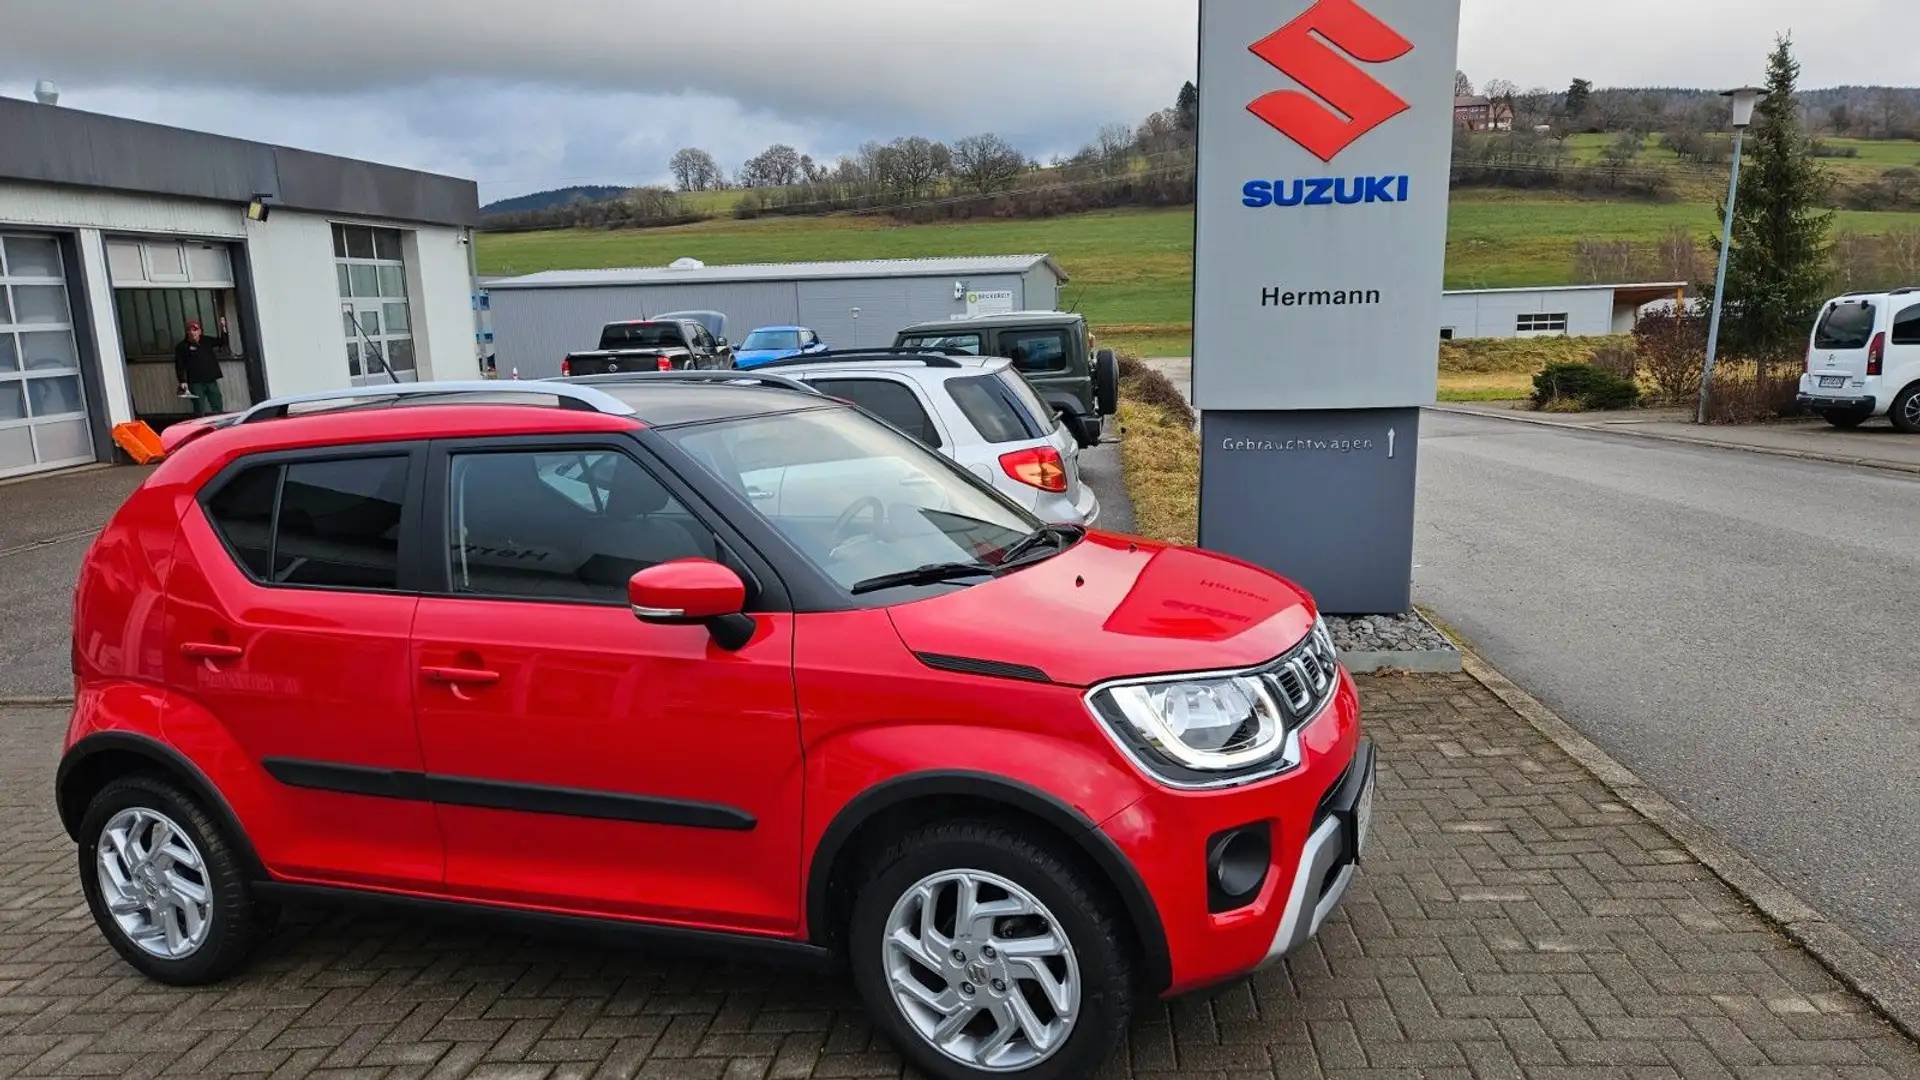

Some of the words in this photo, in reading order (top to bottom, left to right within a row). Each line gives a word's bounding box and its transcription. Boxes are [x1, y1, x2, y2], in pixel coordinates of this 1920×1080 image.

[1241, 175, 1409, 207] SUZUKI
[1261, 287, 1380, 306] Hermann
[1222, 437, 1373, 453] Gebrauchtwagen
